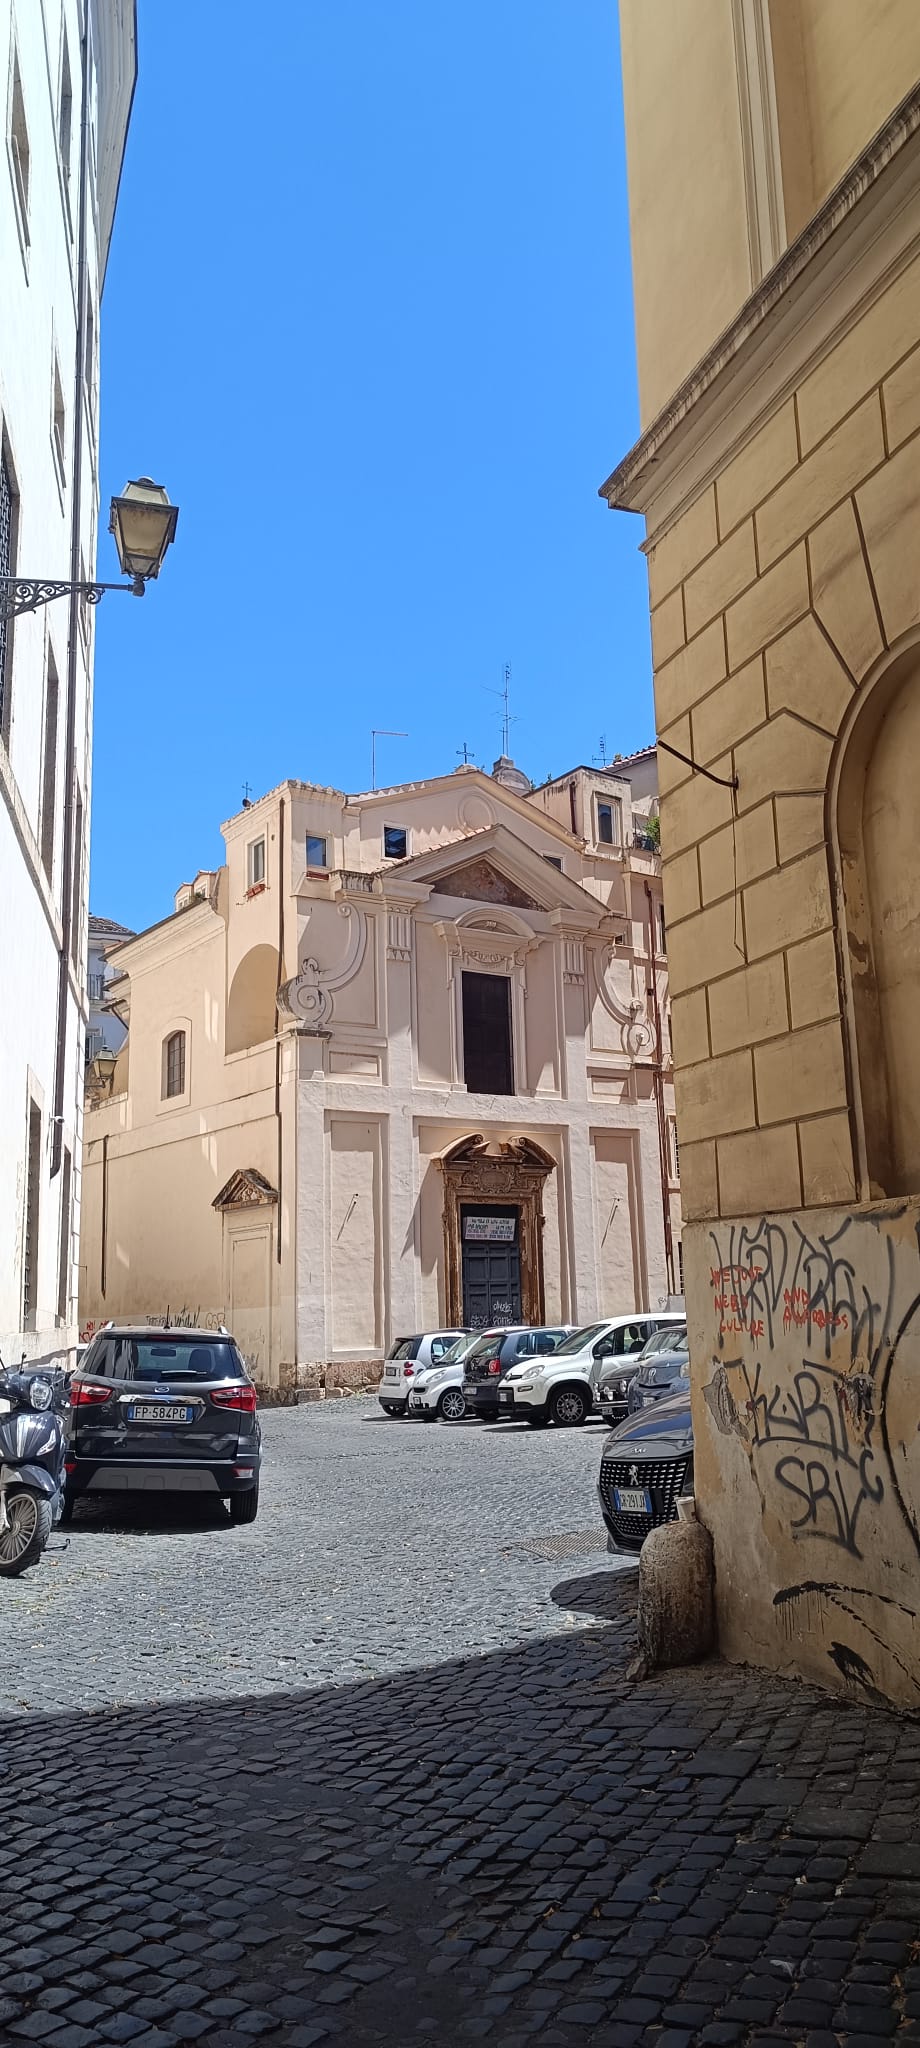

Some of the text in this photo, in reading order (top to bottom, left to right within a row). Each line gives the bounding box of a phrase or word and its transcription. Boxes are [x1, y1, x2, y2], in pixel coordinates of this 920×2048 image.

[710, 1266, 731, 1288] WE
[714, 1294, 749, 1313] NEED
[783, 1287, 810, 1305] AND
